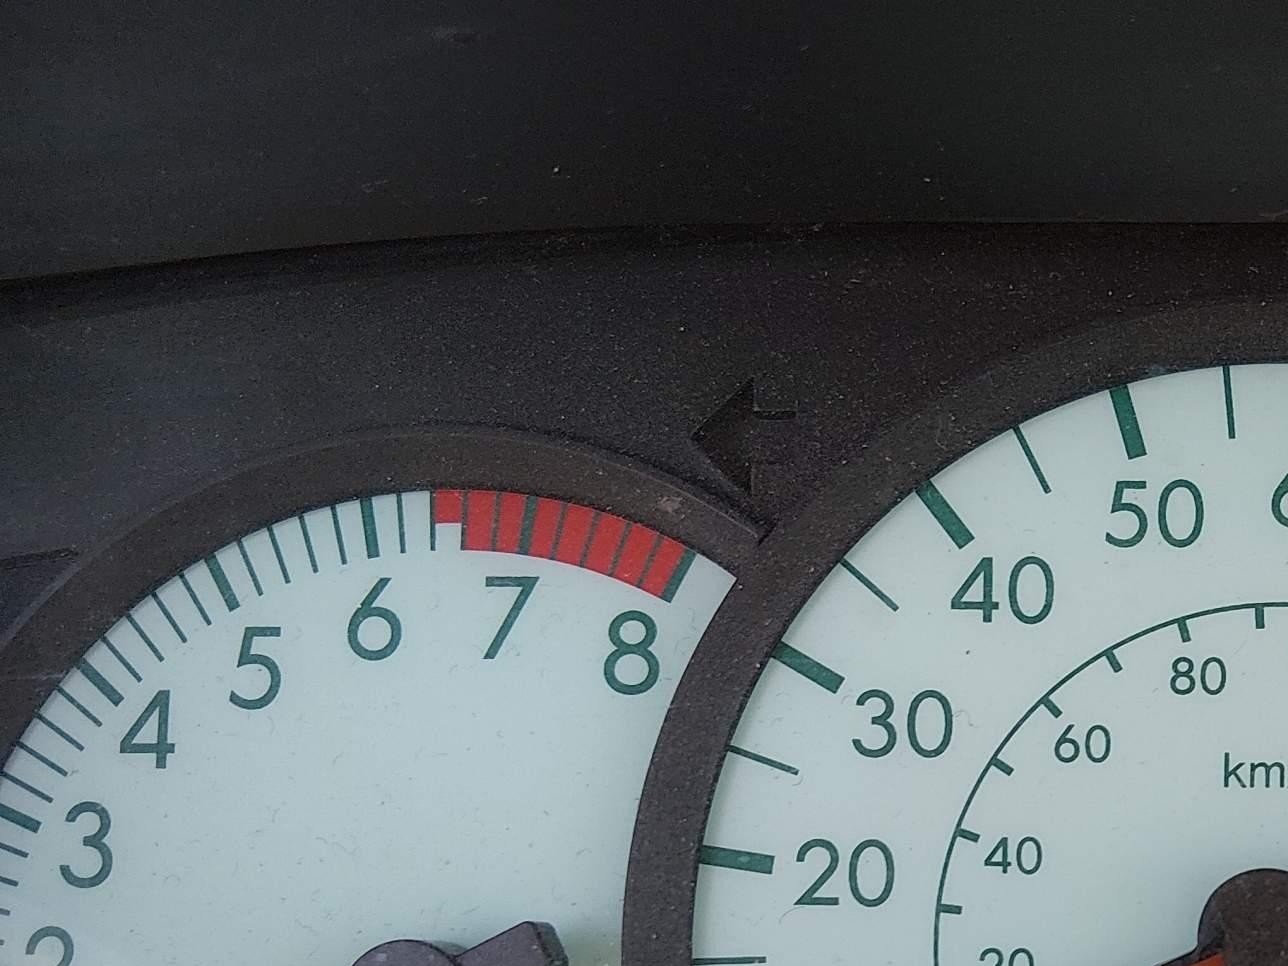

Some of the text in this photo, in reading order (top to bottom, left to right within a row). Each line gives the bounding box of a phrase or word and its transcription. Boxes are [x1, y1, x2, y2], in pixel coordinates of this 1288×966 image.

[1105, 479, 1203, 548] 50
[347, 576, 403, 661] 6
[484, 575, 540, 660] 7
[950, 556, 1055, 624] 40
[229, 626, 281, 710] 5
[603, 609, 661, 695] 8
[1169, 657, 1227, 695] 80
[119, 689, 176, 769] 4
[851, 689, 954, 758] 30
[1053, 724, 1112, 764] 60
[58, 801, 113, 889] 3
[793, 838, 895, 908] 20
[983, 836, 1043, 875] 40
